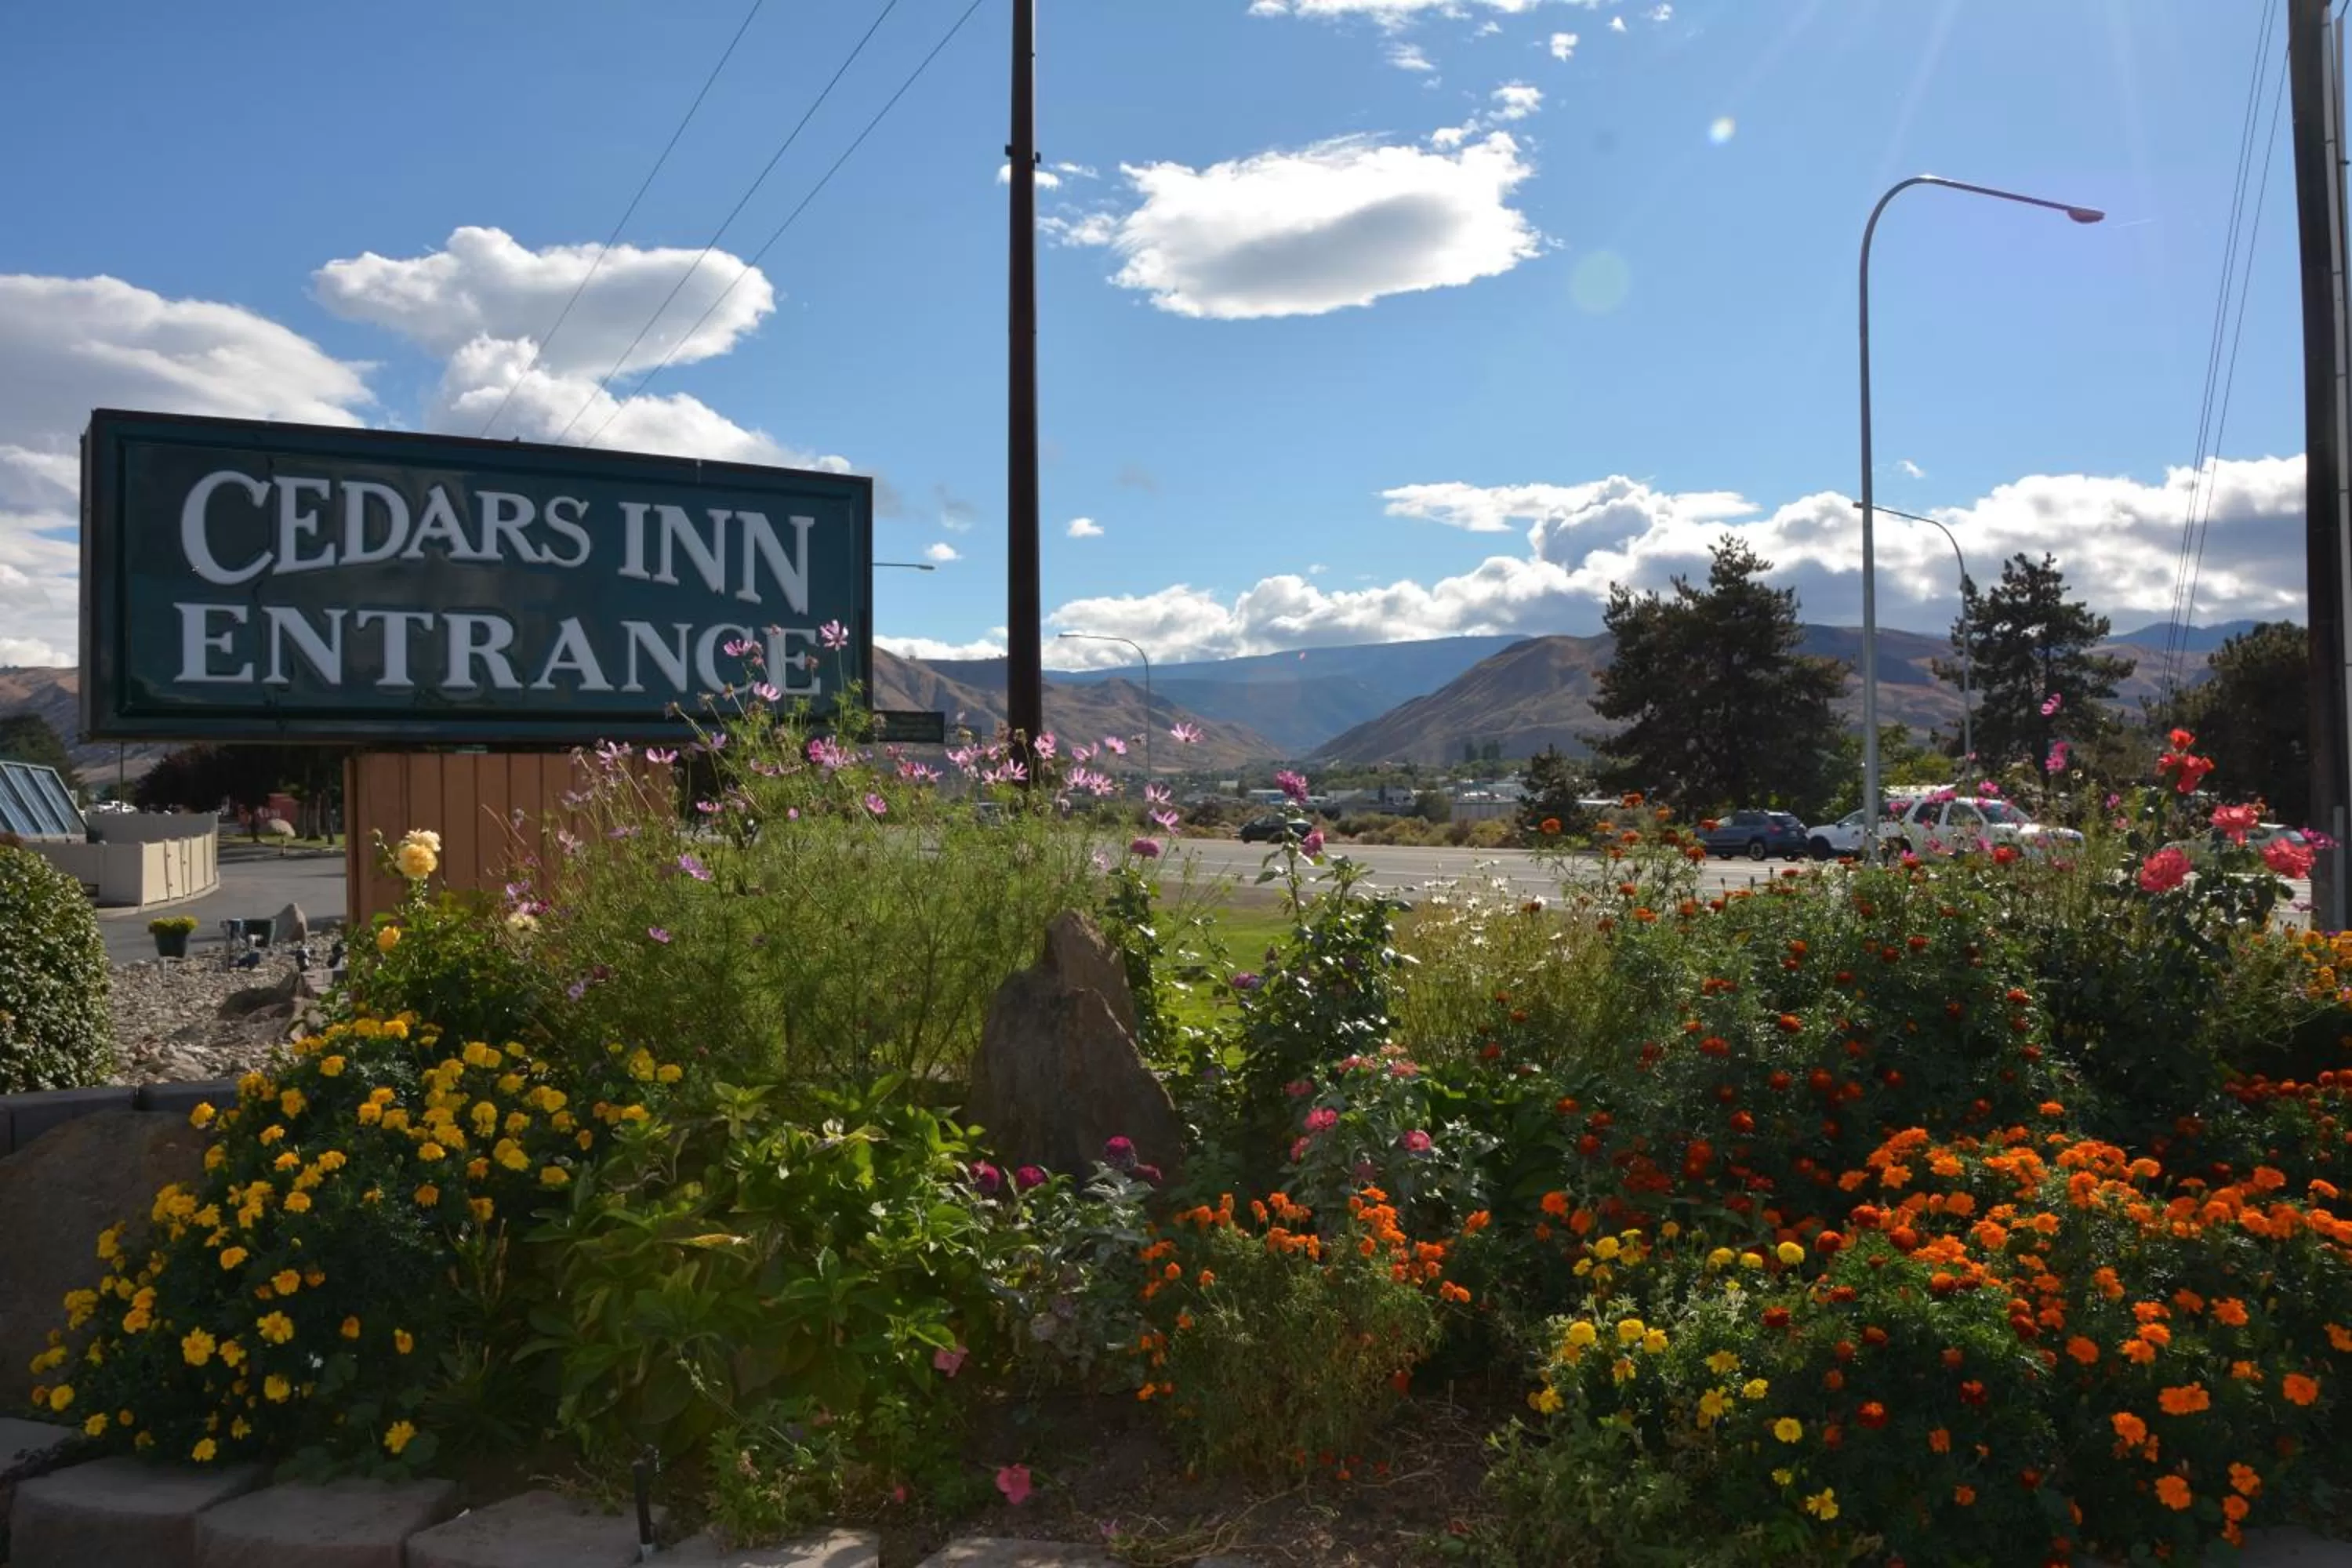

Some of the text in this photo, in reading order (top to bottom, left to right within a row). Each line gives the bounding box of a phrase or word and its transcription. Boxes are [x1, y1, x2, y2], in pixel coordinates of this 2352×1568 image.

[180, 470, 815, 615] CEDARS INN
[173, 602, 821, 695] ENTRANCE
